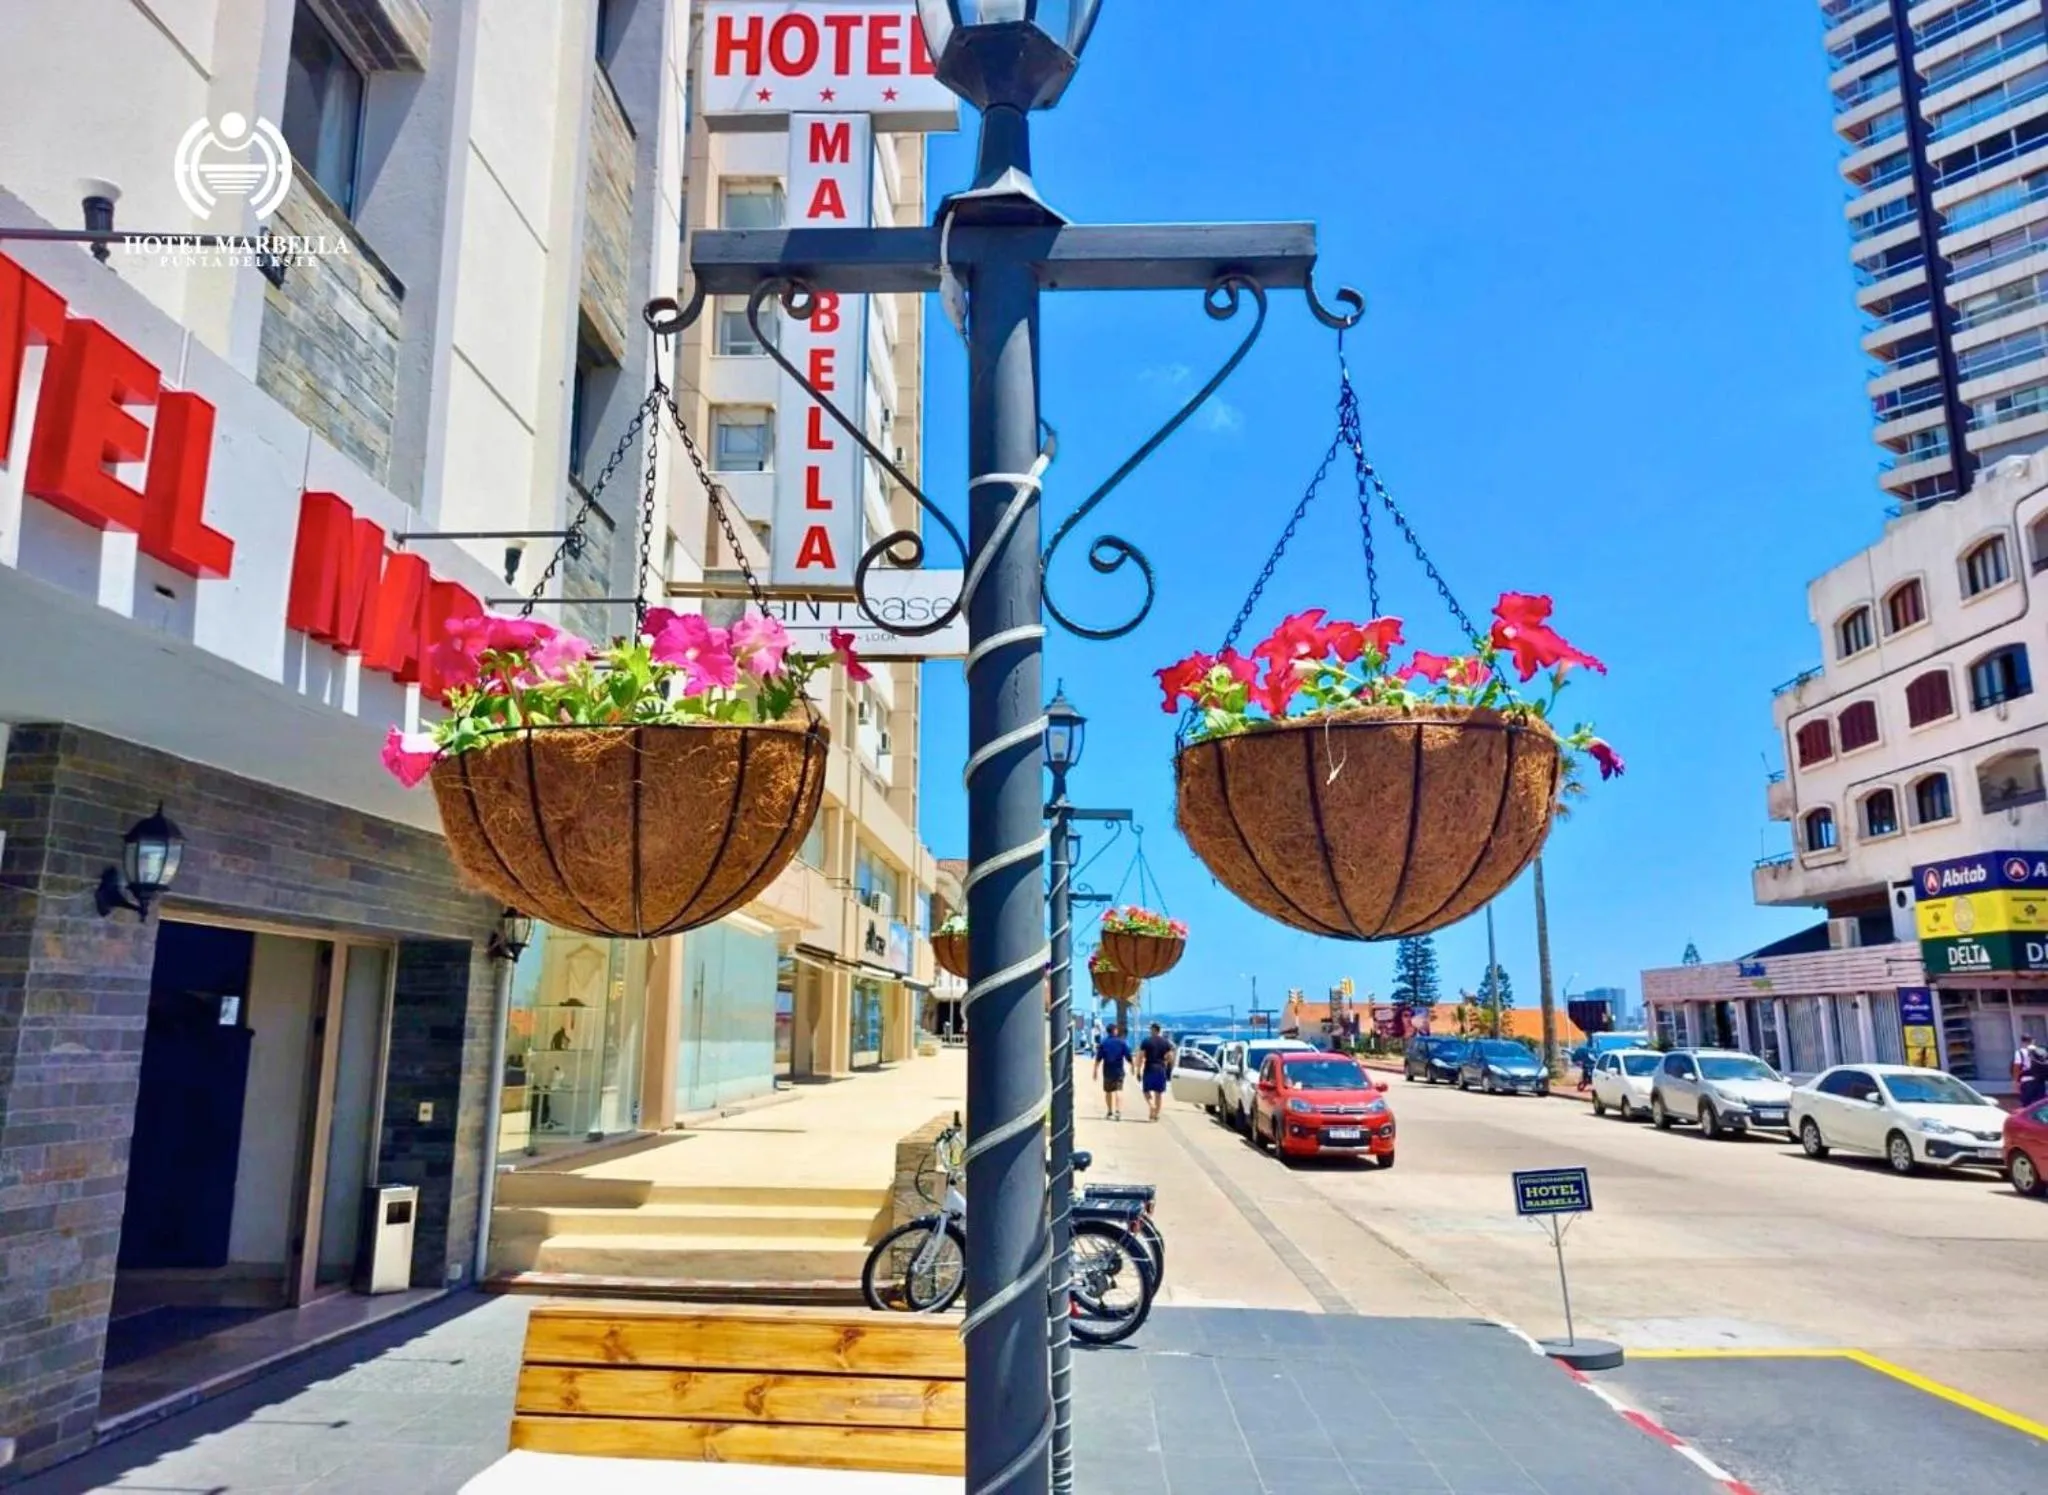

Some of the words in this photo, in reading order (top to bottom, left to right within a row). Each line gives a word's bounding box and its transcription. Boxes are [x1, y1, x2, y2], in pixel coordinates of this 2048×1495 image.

[714, 13, 938, 77] HOTEL
[796, 122, 849, 569] MABELLA
[1942, 864, 1987, 888] Abitab
[1947, 944, 1991, 966] DELTA
[1525, 1183, 1580, 1198] HOTEL
